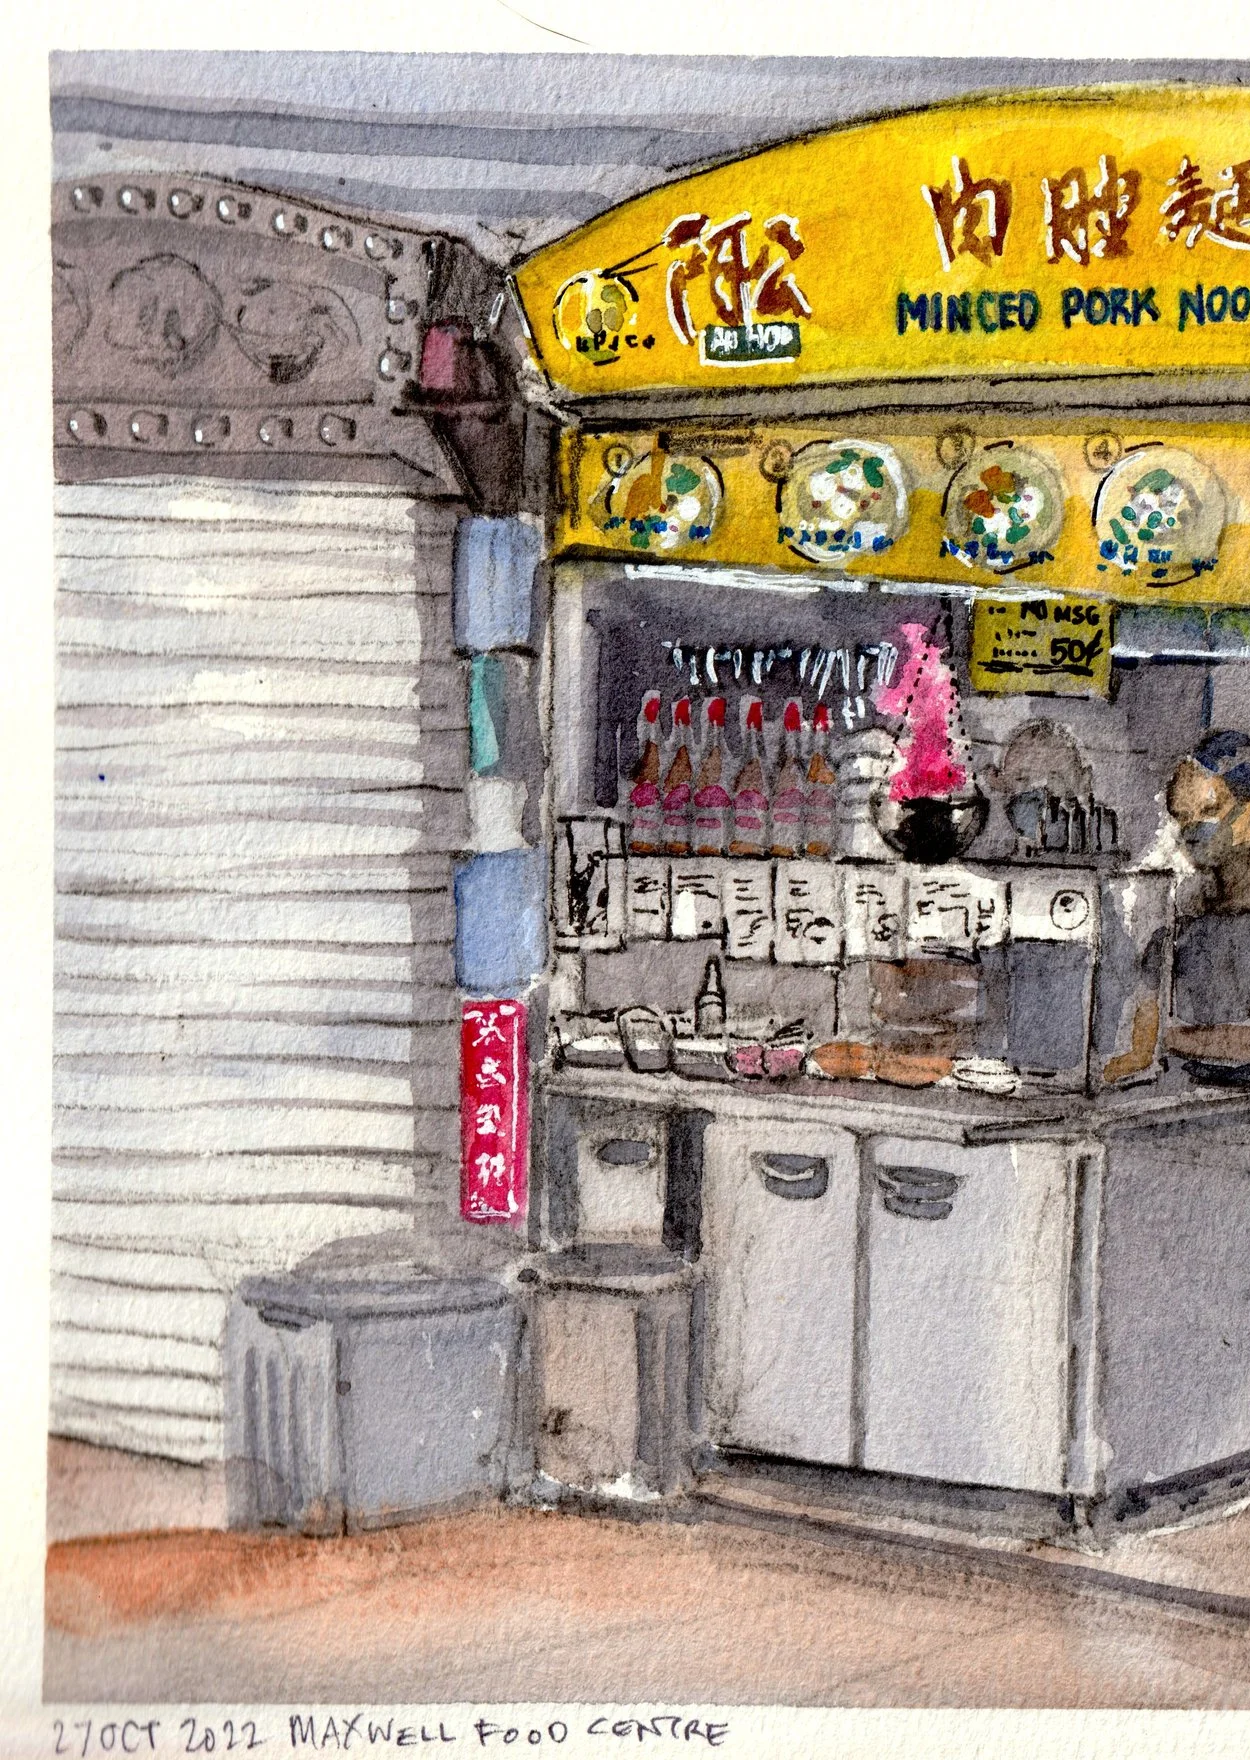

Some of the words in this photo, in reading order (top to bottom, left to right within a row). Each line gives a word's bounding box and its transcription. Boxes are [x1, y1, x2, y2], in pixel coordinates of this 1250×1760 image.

[896, 290, 1042, 336] MINCED
[1062, 285, 1159, 330] PORK
[1054, 605, 1100, 626] MSG
[180, 1717, 264, 1753] 2022
[289, 1713, 457, 1751] MAXWELL
[474, 1718, 568, 1747] FOOD
[587, 1715, 729, 1747] CENTRE
